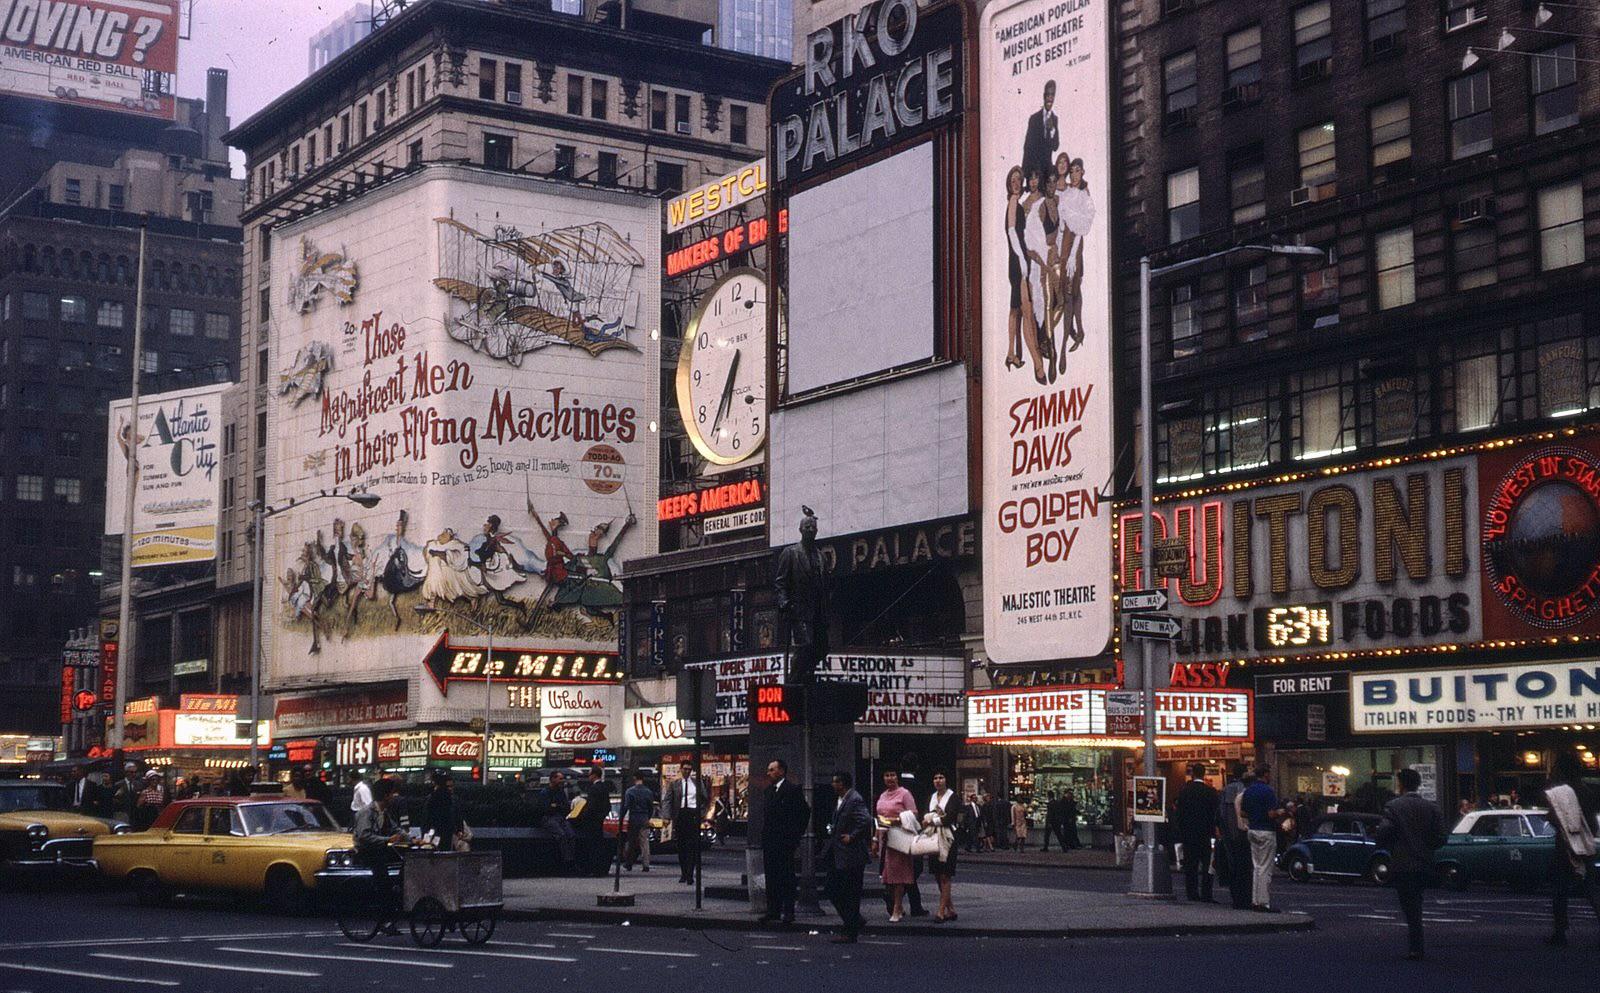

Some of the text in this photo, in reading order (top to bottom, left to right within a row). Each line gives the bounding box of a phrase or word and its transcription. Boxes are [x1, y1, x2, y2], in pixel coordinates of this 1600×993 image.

[805, 0, 917, 96] RKO
[1003, 14, 1083, 61] MUSICAL THEATRE
[4, 47, 138, 78] AMERICAN RED BALL
[1012, 60, 1023, 76] AT
[1026, 52, 1041, 71] ITS
[777, 44, 952, 182] PALACE
[667, 236, 719, 276] MAKERS
[723, 225, 744, 254] OF
[731, 282, 741, 303] 12
[360, 310, 406, 368] Those
[698, 331, 709, 352] 10
[693, 369, 701, 388] 9
[318, 350, 474, 439] Magnificent Men
[698, 405, 707, 424] 8
[1009, 383, 1093, 438] SAMMY
[142, 399, 210, 448] Atlantic
[751, 417, 760, 436] 5
[334, 386, 636, 485] in their Flying Machines
[732, 431, 741, 450] 6
[170, 435, 218, 481] City
[587, 452, 621, 461] TODD-AO
[1011, 424, 1082, 476] DAVIS
[143, 473, 167, 481] SUMMER
[420, 473, 427, 484] to
[432, 471, 460, 486] Paris
[463, 474, 474, 483] in
[476, 465, 489, 480] 25
[489, 458, 513, 475] hours
[515, 459, 531, 470] and
[541, 460, 570, 473] minutes
[593, 464, 612, 478] 70
[657, 479, 761, 520] KEEPS AMERICA
[1488, 462, 1536, 540] LOWEST
[1539, 456, 1562, 477] IN
[998, 485, 1098, 534] GOLDEN
[704, 517, 731, 533] GENERAL
[732, 514, 746, 528] TIME
[851, 521, 975, 572] PALACE
[1026, 527, 1079, 568] BOY
[1002, 585, 1096, 612] MAJESTIC THEATRE
[1124, 596, 1162, 607] ONE WAY
[1029, 614, 1043, 624] WEST
[1133, 619, 1175, 632] ONE WAY
[1342, 592, 1470, 642] FOODS
[749, 658, 767, 672] JAN
[840, 656, 914, 673] VERDON AS
[1273, 677, 1332, 693] FOR RENT
[548, 690, 603, 710] Whelan
[905, 693, 963, 708] COMEDY
[973, 693, 1083, 714] THE HOURS
[1107, 706, 1138, 715] BUS STOP
[1155, 695, 1237, 712] HOURS
[365, 705, 373, 719] AT
[375, 704, 388, 719] BOX
[1364, 711, 1417, 726] ITALIAN
[1427, 709, 1476, 723] FOODS
[1497, 706, 1524, 720] TRY
[1533, 703, 1576, 719] THEM
[986, 714, 1067, 733] OF LOVE
[1160, 715, 1221, 732] LOVE
[400, 738, 427, 753] DRINKS
[436, 740, 479, 757] Coca-Cola
